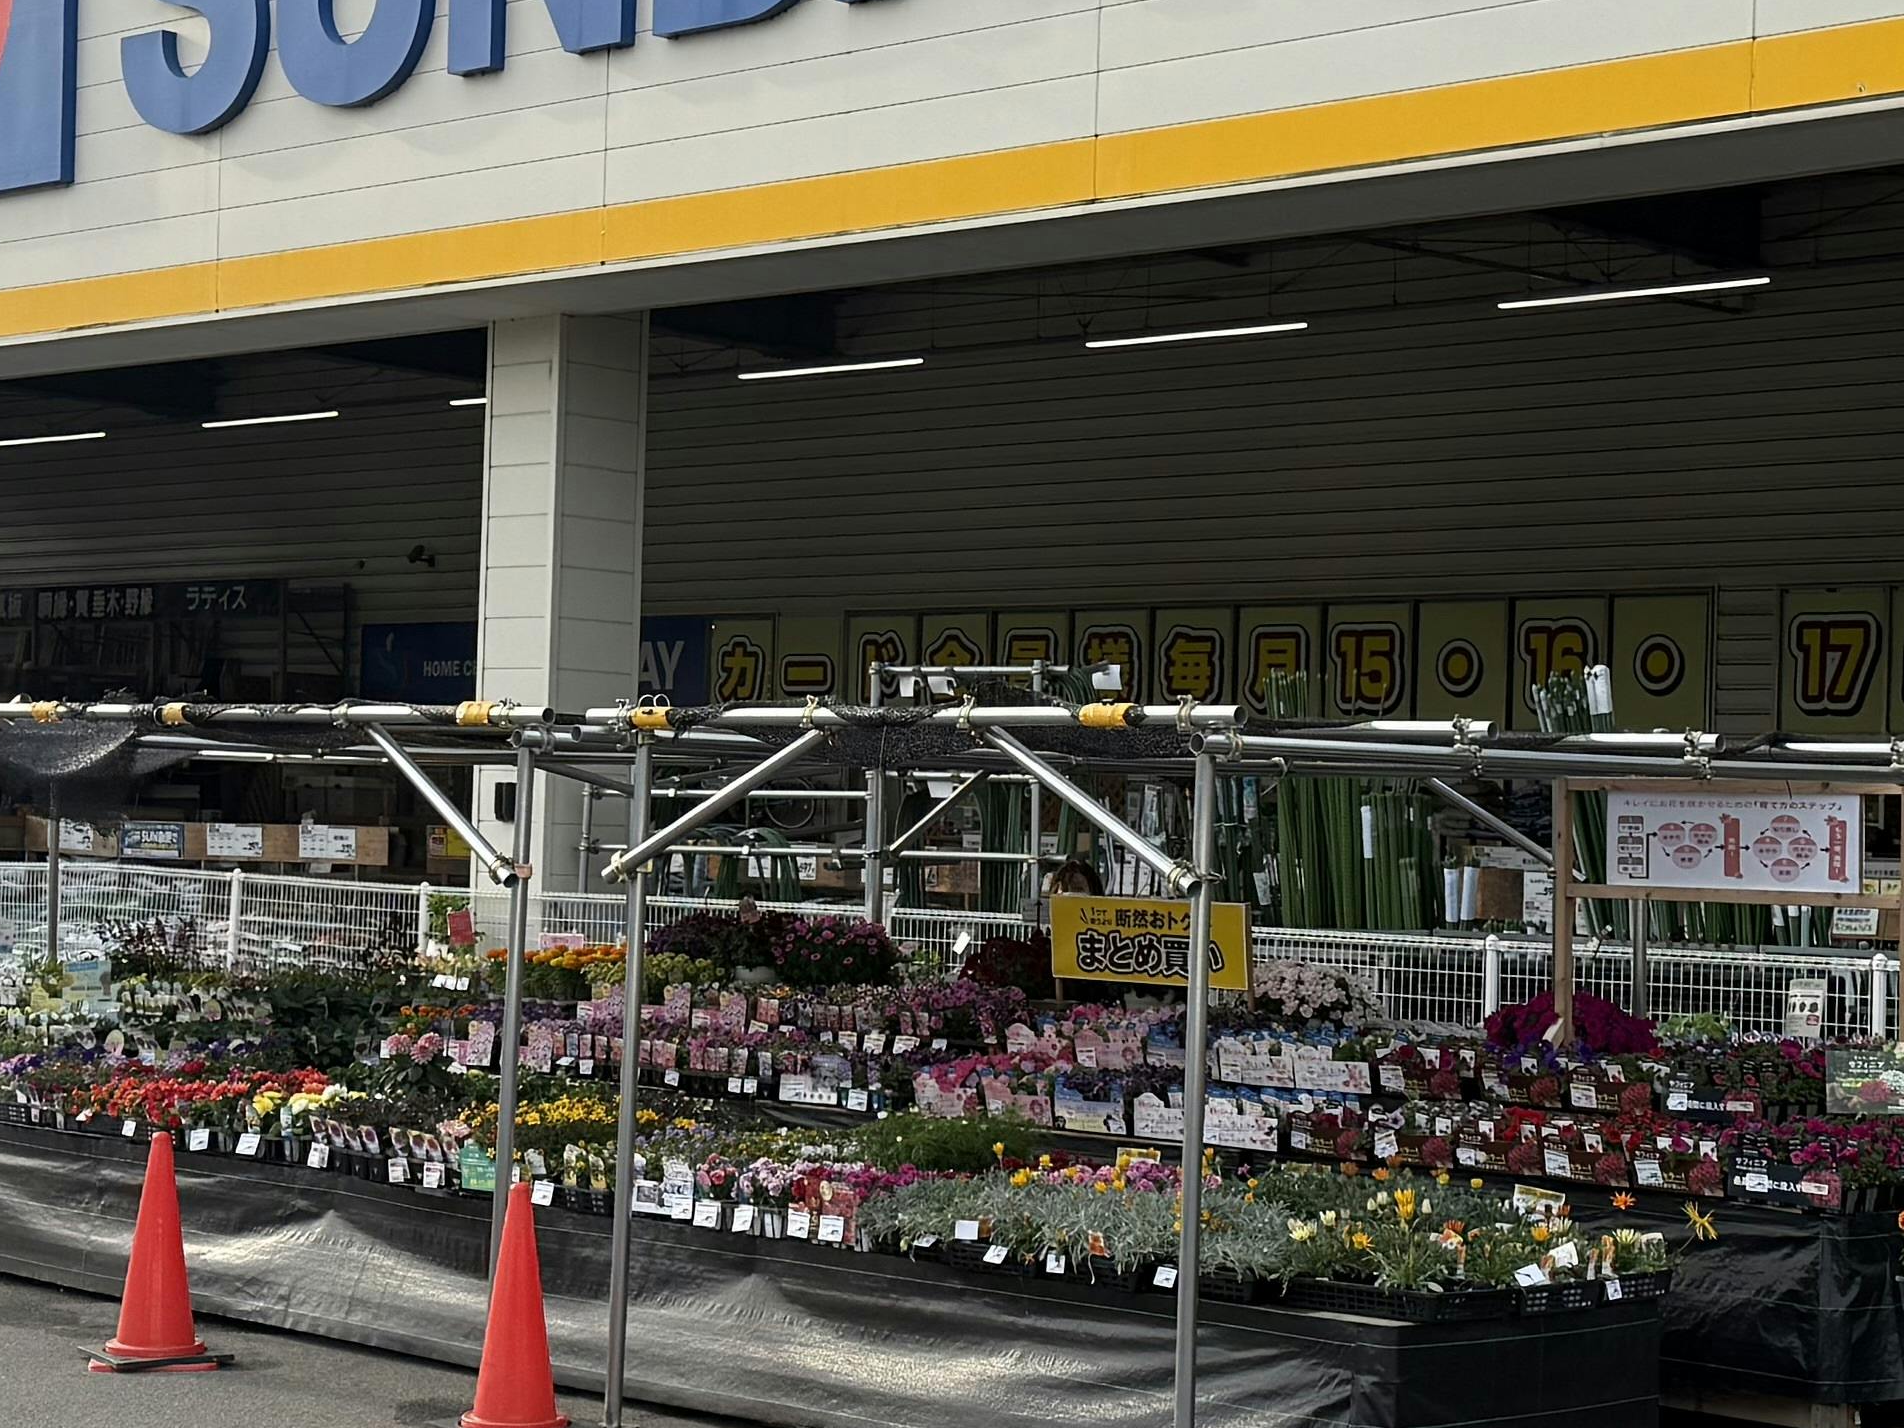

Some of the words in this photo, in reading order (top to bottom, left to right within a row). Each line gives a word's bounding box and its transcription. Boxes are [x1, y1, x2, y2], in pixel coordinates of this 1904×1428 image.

[185, 586, 248, 611] ラティス
[423, 661, 460, 677] HOME
